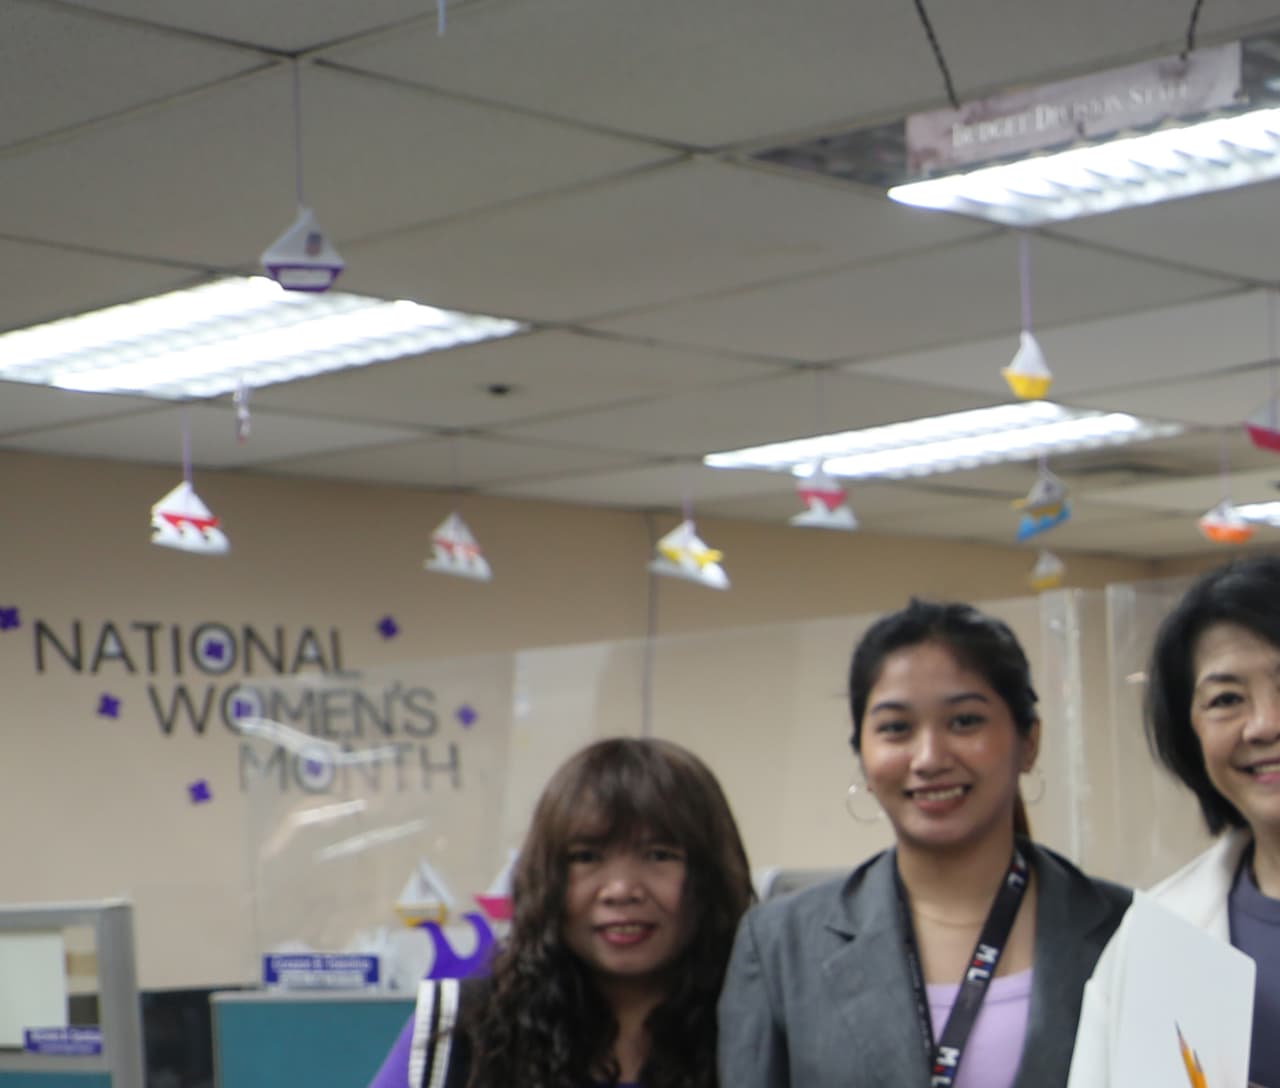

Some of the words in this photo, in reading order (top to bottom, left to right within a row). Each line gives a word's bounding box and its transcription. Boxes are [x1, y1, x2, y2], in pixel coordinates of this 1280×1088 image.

[34, 619, 362, 678] NATIONAL
[148, 684, 441, 738] WOMEN'S
[238, 742, 464, 794] MONTH
